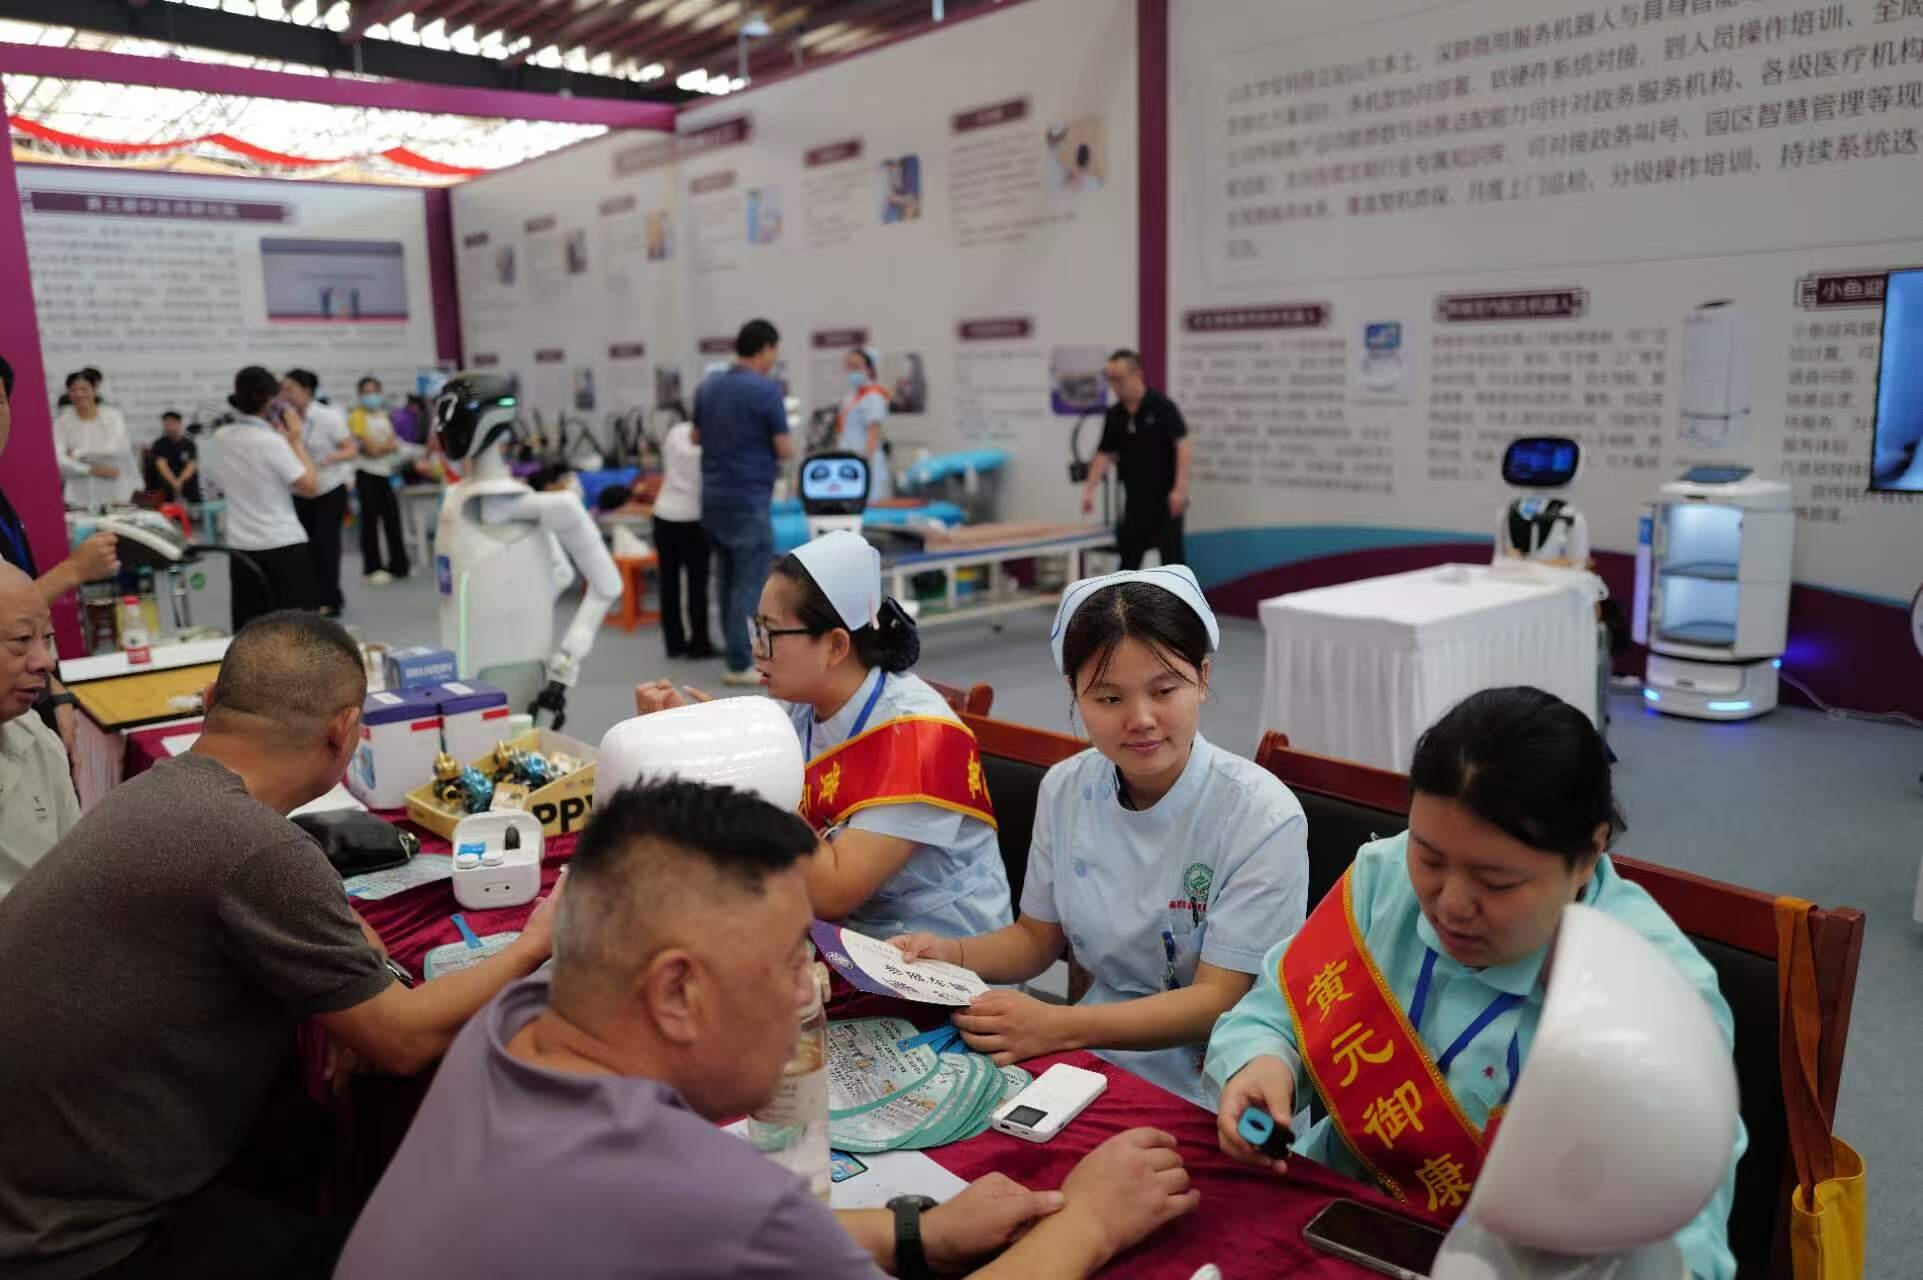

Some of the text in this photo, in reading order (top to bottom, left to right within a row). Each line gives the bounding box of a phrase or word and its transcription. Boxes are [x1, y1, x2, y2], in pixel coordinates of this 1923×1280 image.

[532, 794, 592, 833] PP
[1306, 960, 1472, 1211] 黄元御康
